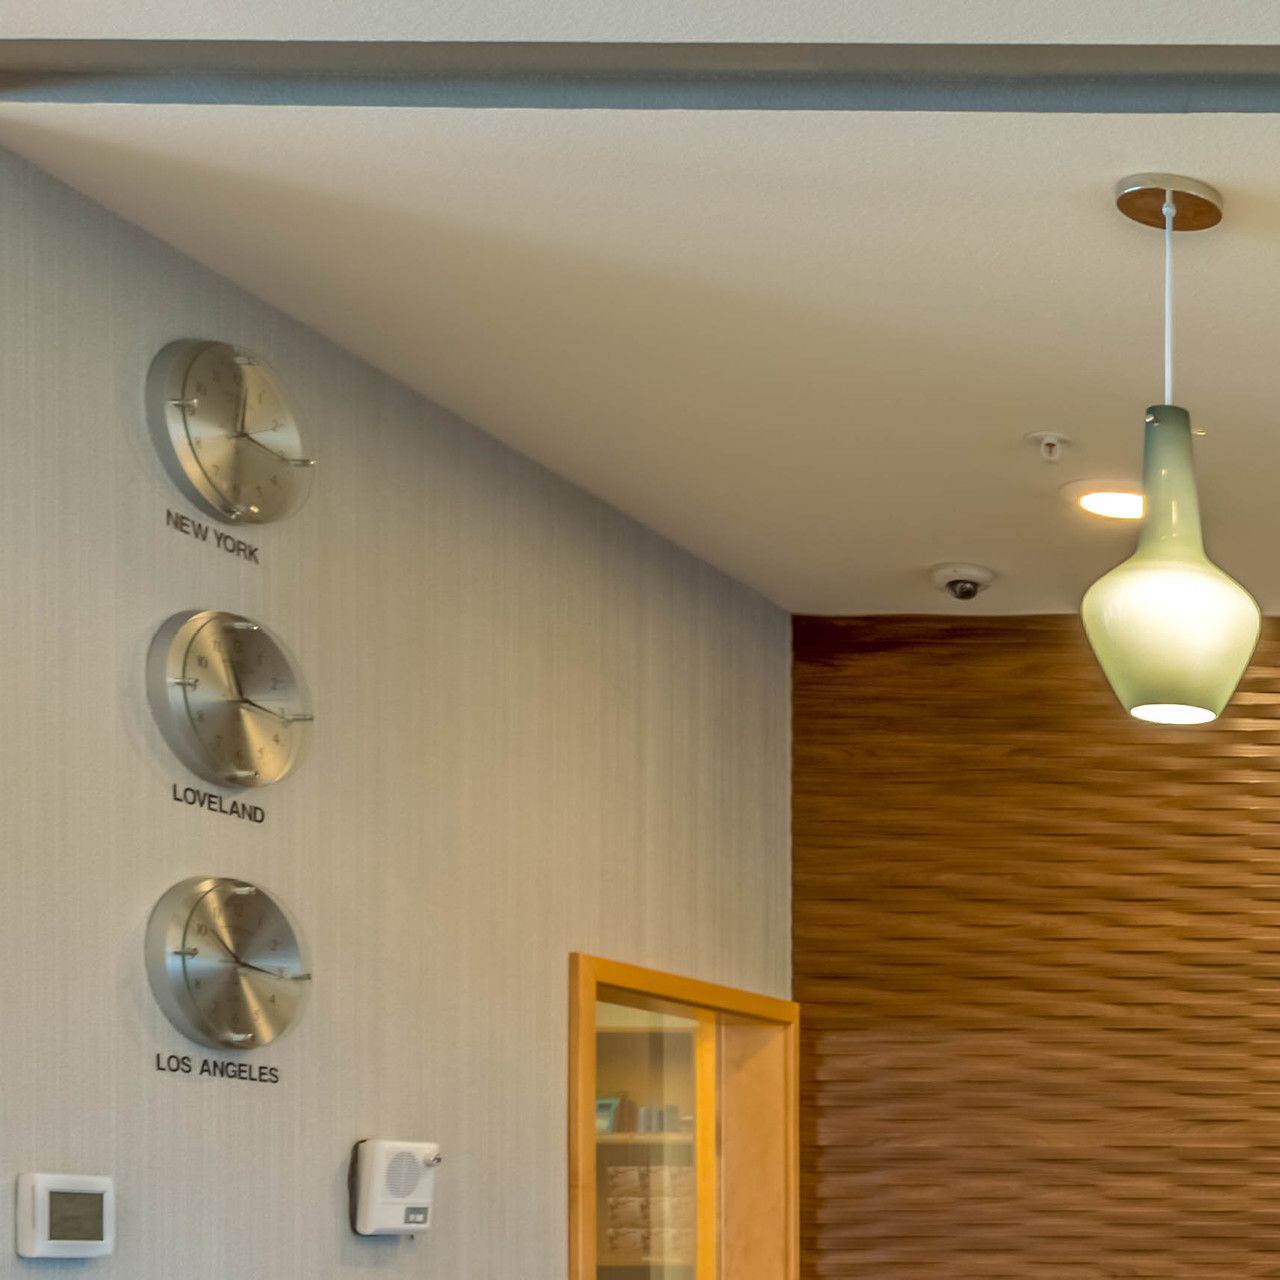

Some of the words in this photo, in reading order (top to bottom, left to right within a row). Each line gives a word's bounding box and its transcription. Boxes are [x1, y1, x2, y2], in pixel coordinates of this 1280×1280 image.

[166, 508, 209, 542] NEW
[213, 529, 260, 564] YORK
[172, 783, 265, 823] LOVELAND
[156, 1053, 192, 1073] LOS
[200, 1059, 279, 1084] ANGELES
